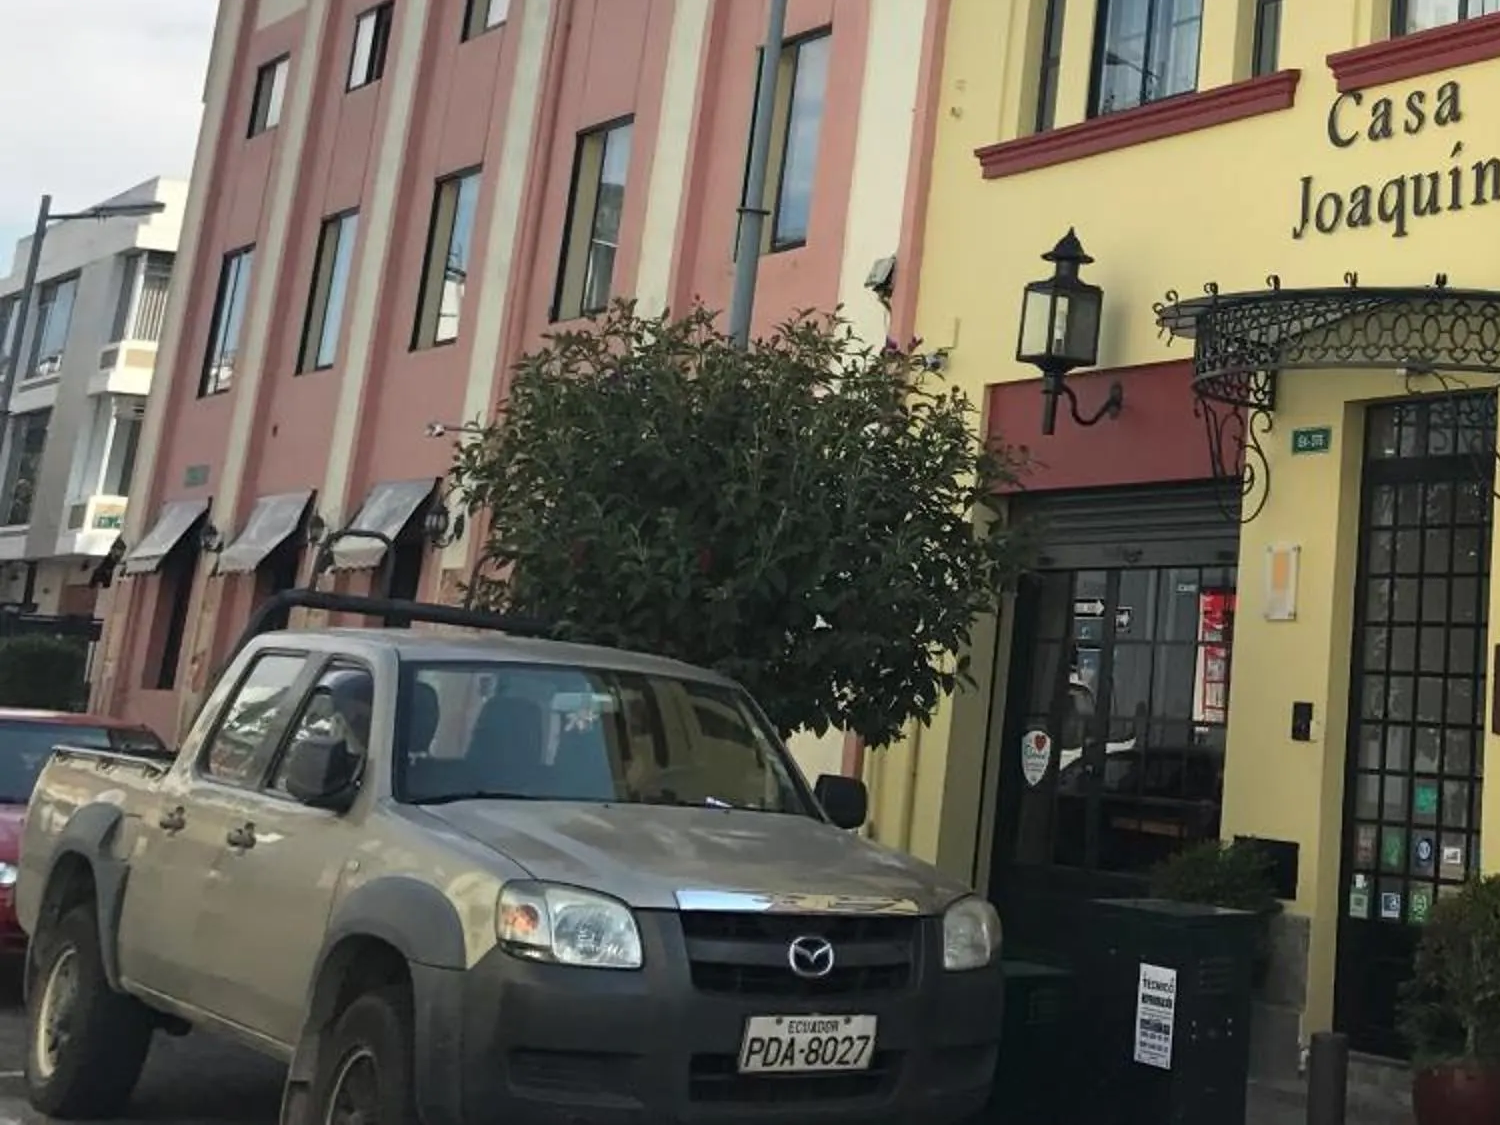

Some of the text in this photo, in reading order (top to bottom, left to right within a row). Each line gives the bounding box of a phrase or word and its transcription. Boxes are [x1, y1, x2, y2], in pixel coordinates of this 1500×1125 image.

[1327, 79, 1463, 148] Casa
[787, 1020, 839, 1034] ECUADOR
[744, 1035, 871, 1067] PDA-8027
